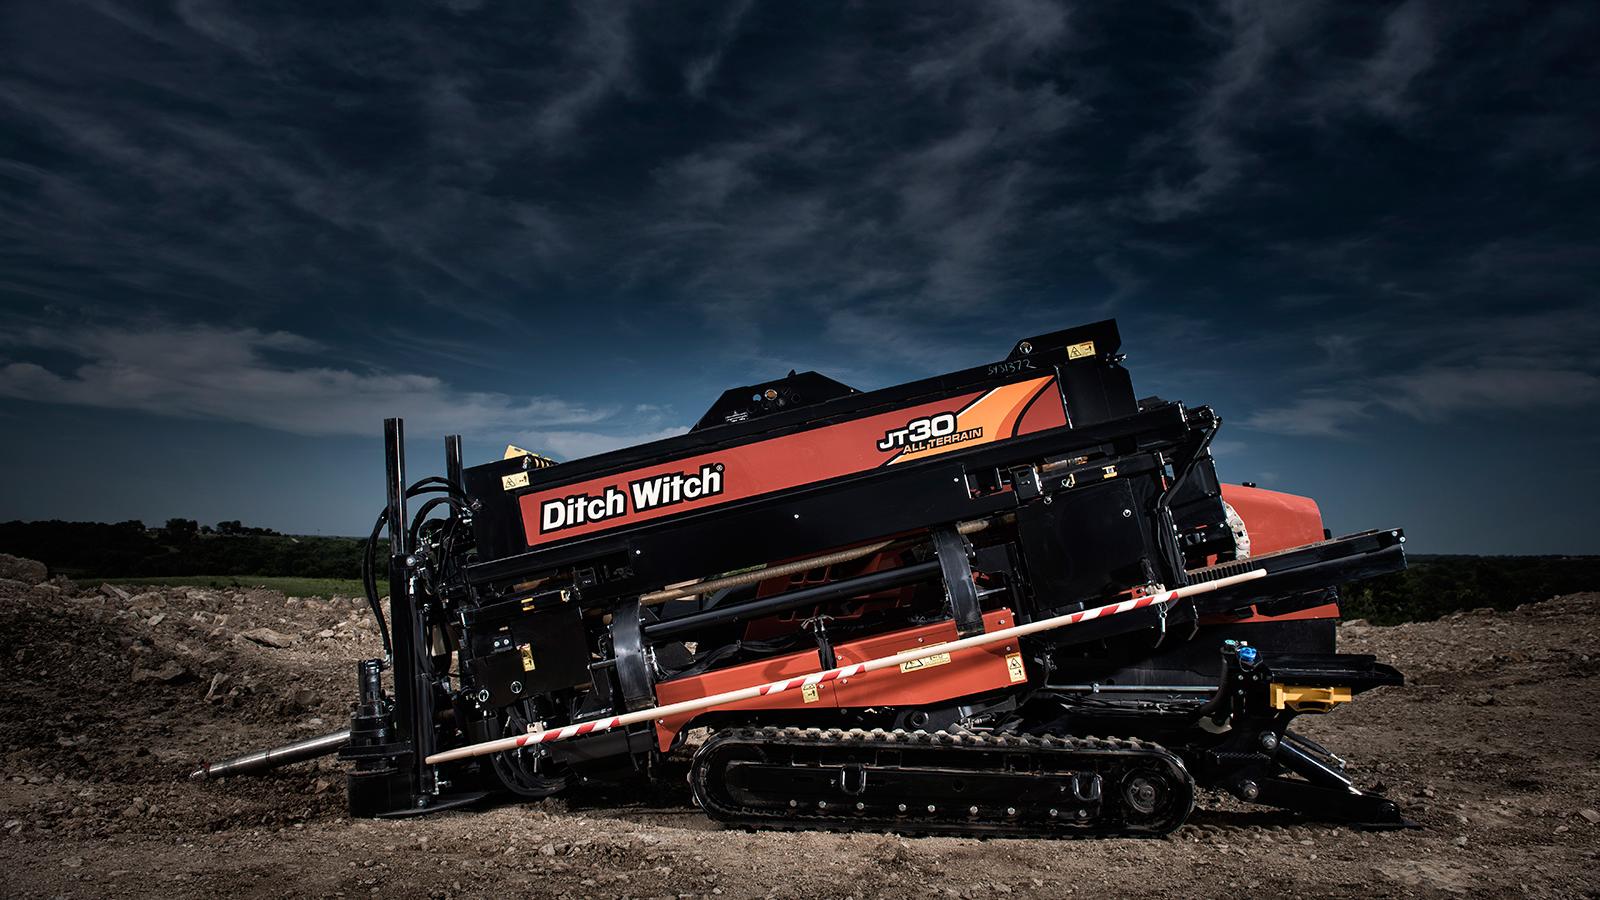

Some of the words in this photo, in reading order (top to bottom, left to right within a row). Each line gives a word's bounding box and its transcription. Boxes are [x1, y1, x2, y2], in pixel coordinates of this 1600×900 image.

[879, 413, 955, 449] JT30
[903, 442, 926, 454] ALL
[928, 428, 982, 448] TERRAIN
[542, 489, 624, 531] Ditch
[632, 467, 721, 510] Witch
